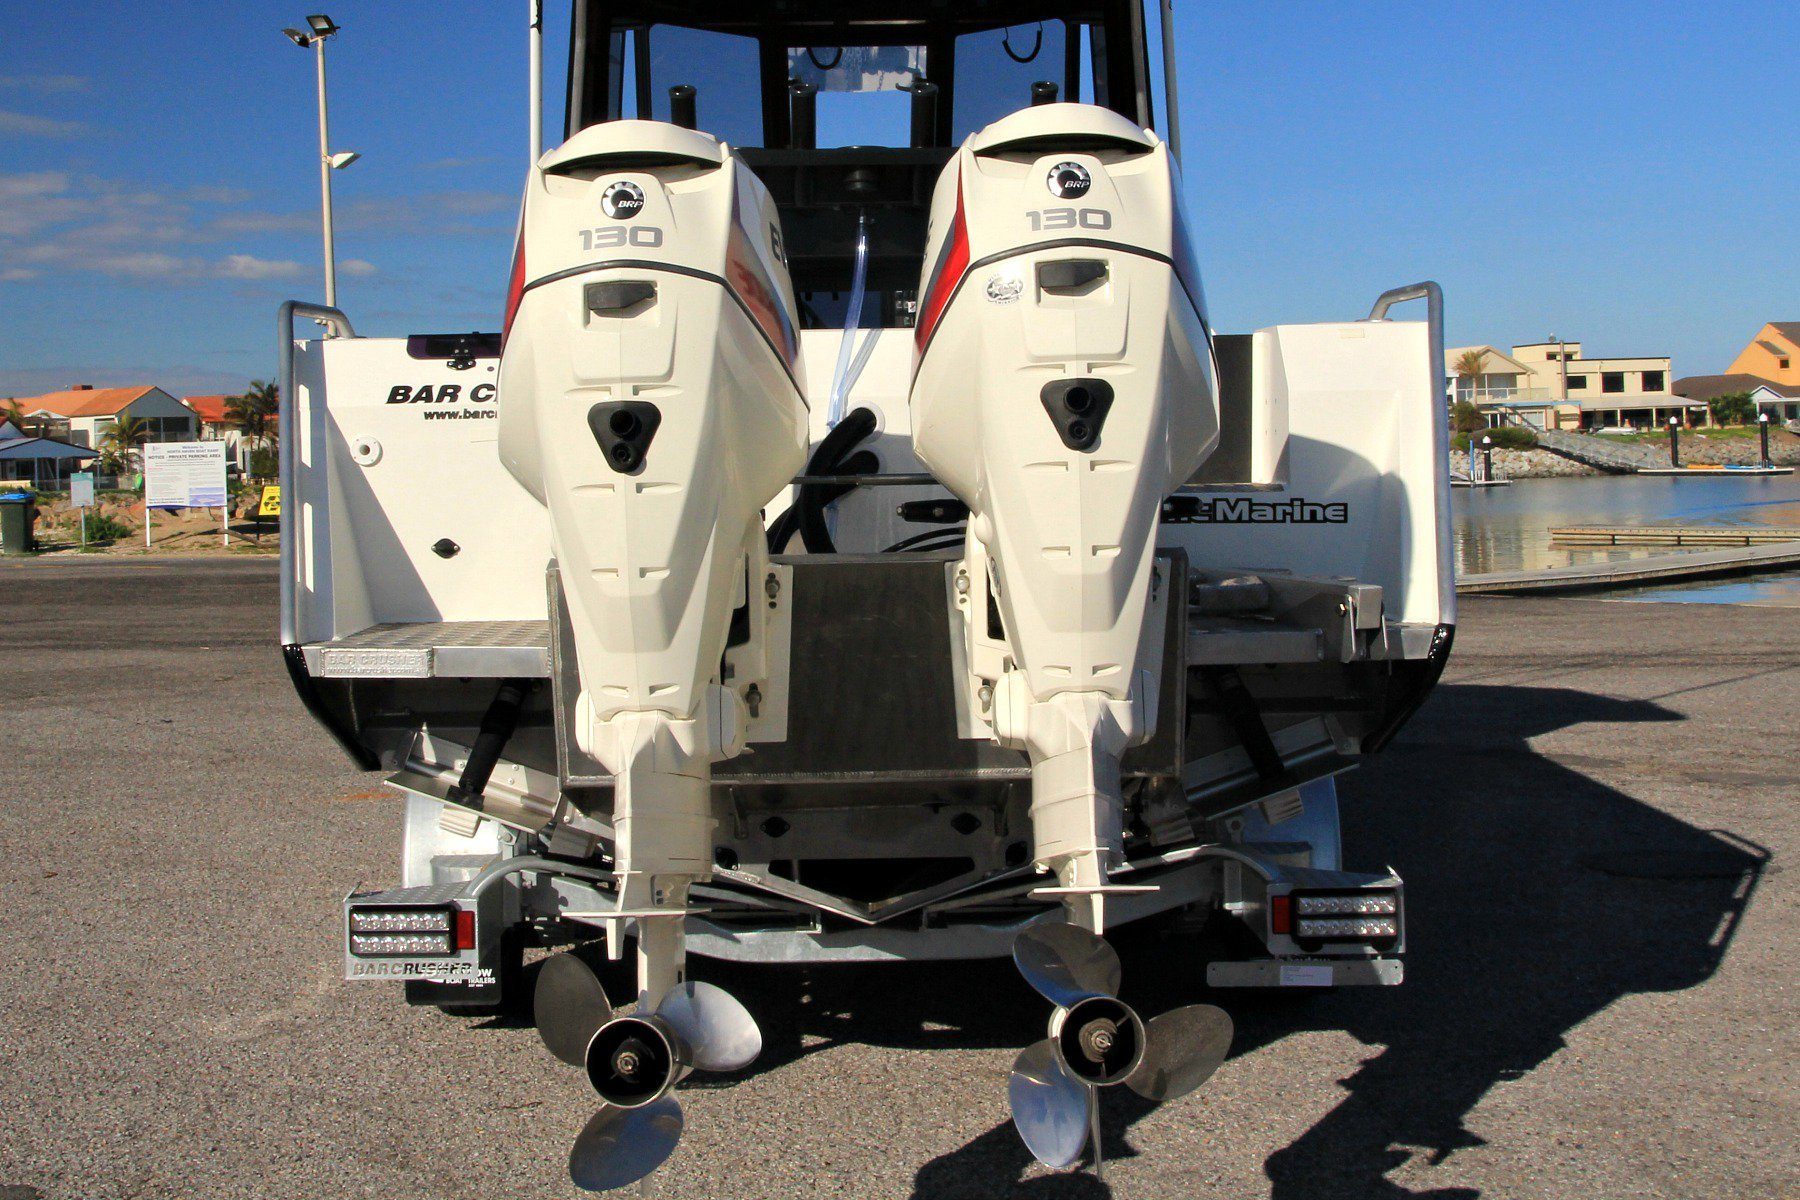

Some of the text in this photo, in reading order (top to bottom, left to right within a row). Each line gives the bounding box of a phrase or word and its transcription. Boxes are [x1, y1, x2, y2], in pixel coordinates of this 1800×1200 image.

[1065, 180, 1089, 188] BRP
[618, 200, 643, 208] BRP
[1026, 208, 1111, 231] 130
[579, 226, 663, 250] 130
[385, 383, 498, 404] BAR C
